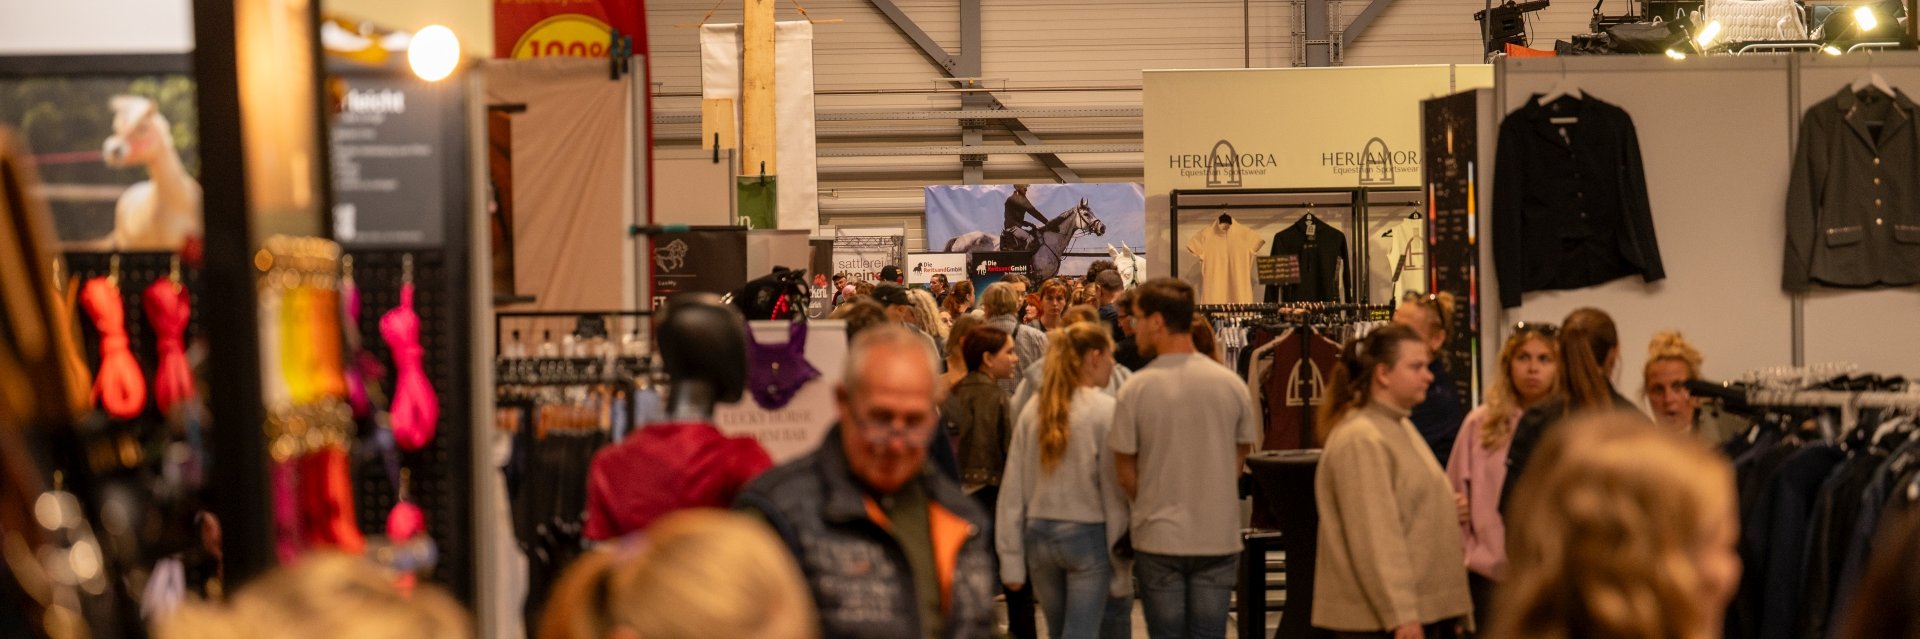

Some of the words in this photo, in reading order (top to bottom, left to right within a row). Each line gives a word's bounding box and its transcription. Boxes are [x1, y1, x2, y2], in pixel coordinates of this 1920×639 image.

[1169, 153, 1277, 168] HERLAMORA
[1180, 168, 1221, 178] Equestrian
[1223, 167, 1266, 177] Sportswear
[1333, 166, 1374, 175] Equestrian
[1375, 164, 1419, 174] Sportswear
[838, 257, 885, 269] sattlerei
